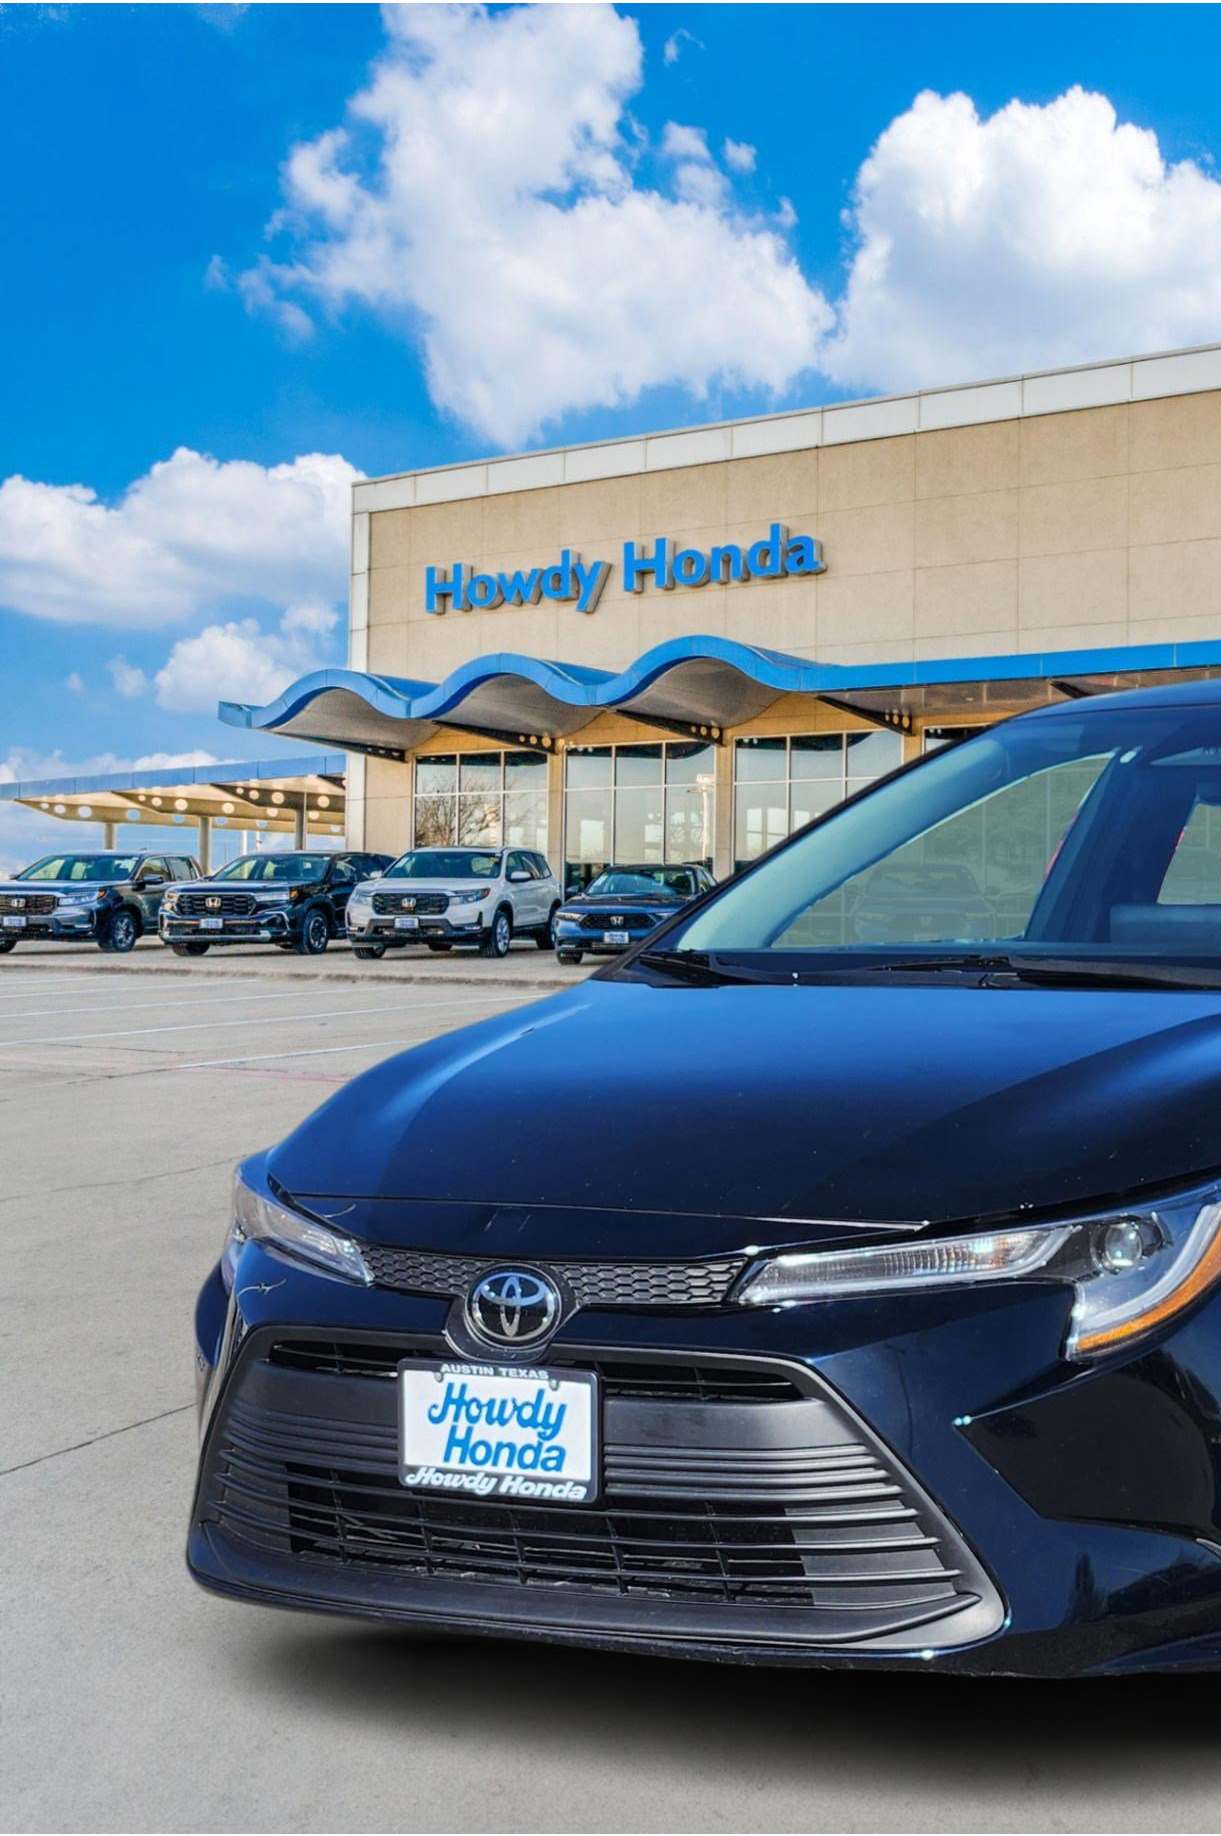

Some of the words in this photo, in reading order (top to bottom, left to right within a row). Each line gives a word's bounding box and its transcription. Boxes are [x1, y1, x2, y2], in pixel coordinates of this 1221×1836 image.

[425, 548, 612, 615] Howdy
[622, 523, 826, 593] Honda
[440, 1363, 495, 1376] AUSTIN
[499, 1367, 550, 1380] TEXAS
[427, 1382, 568, 1441] Howdy
[442, 1424, 567, 1472] Honda
[405, 1466, 498, 1495] Howdy
[499, 1475, 588, 1500] Honda
